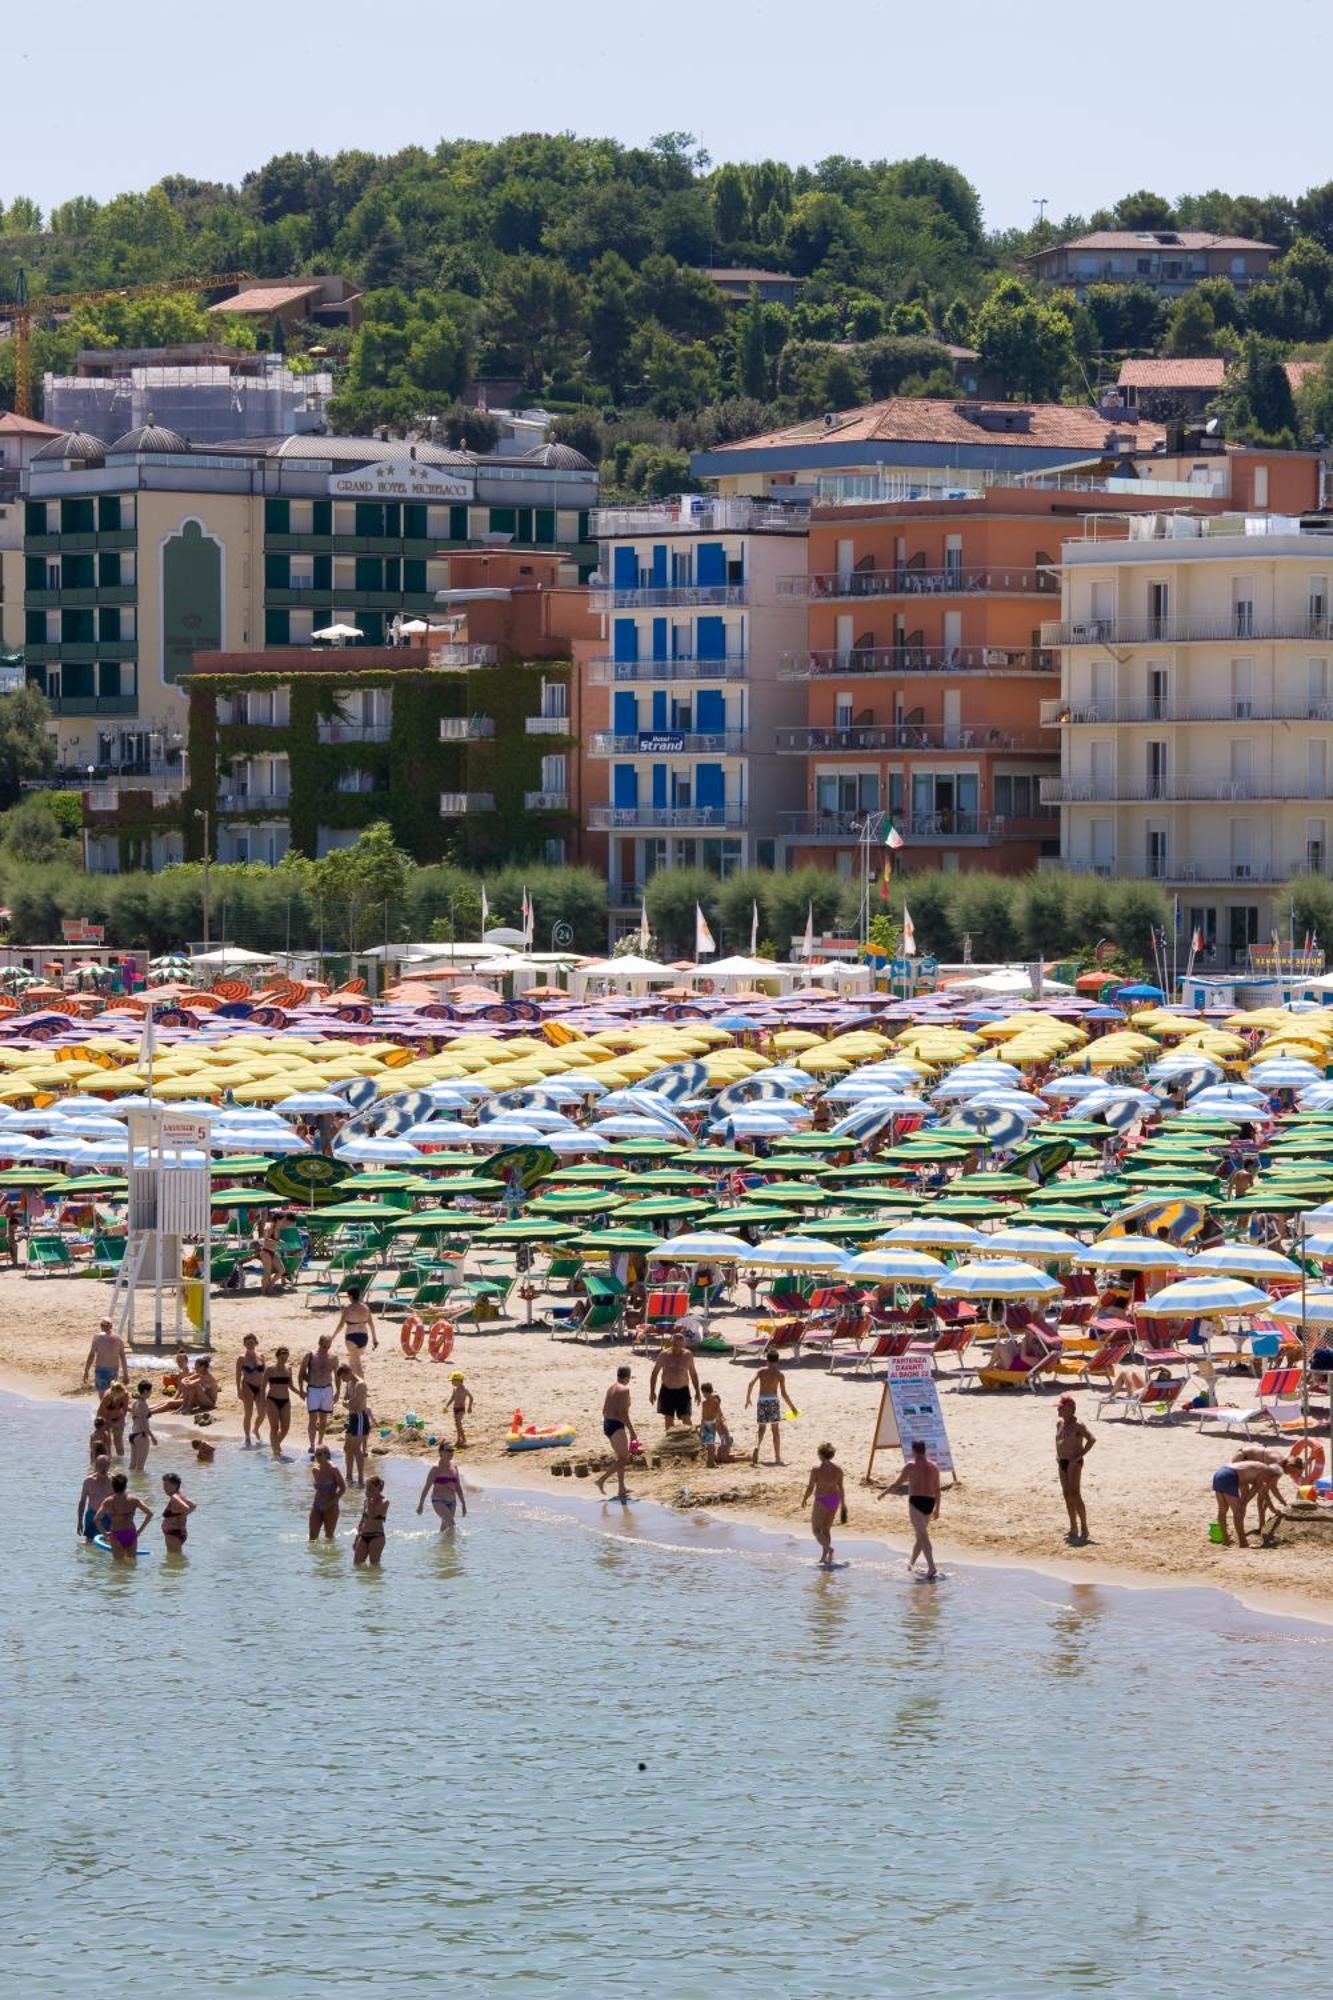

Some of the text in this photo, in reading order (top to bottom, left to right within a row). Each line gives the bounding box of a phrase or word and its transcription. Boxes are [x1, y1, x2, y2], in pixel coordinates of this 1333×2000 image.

[336, 480, 373, 492] GRAND
[377, 482, 407, 493] HOTEL
[640, 740, 683, 751] Strand
[198, 1126, 206, 1140] 5
